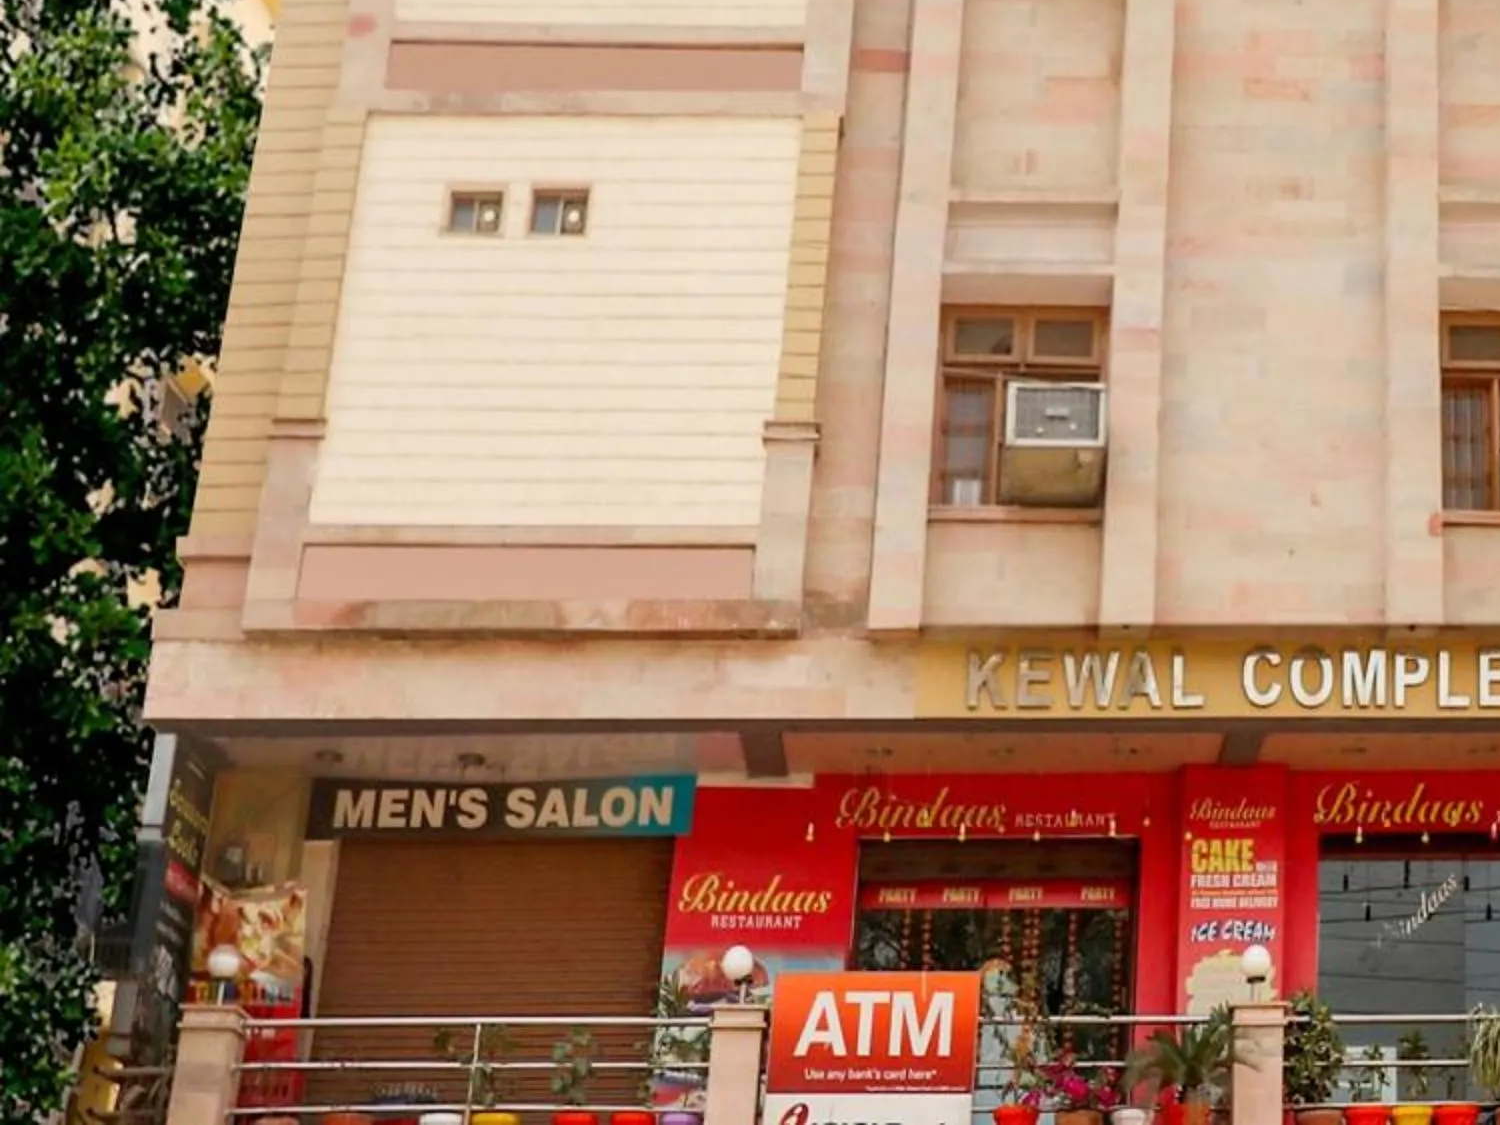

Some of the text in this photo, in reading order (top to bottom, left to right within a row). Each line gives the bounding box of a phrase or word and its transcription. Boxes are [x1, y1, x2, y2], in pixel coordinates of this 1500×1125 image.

[964, 648, 1205, 712] KEWAL
[333, 786, 674, 829] MEN'S SALON
[835, 786, 1117, 828] Bindaas RESTAURANT
[1189, 797, 1276, 821] Bindaas
[1313, 781, 1484, 824] Bindaas
[1191, 838, 1255, 873] CAKE
[678, 870, 833, 914] Bindaas
[1190, 874, 1277, 888] FRESH CREAM
[711, 914, 803, 929] RESTAURANT
[1191, 918, 1276, 942] ICE CREAM
[793, 991, 954, 1057] ATM
[804, 1068, 825, 1081] Use
[826, 1069, 846, 1083] any
[848, 1067, 881, 1081] bank's
[882, 1068, 907, 1081] card
